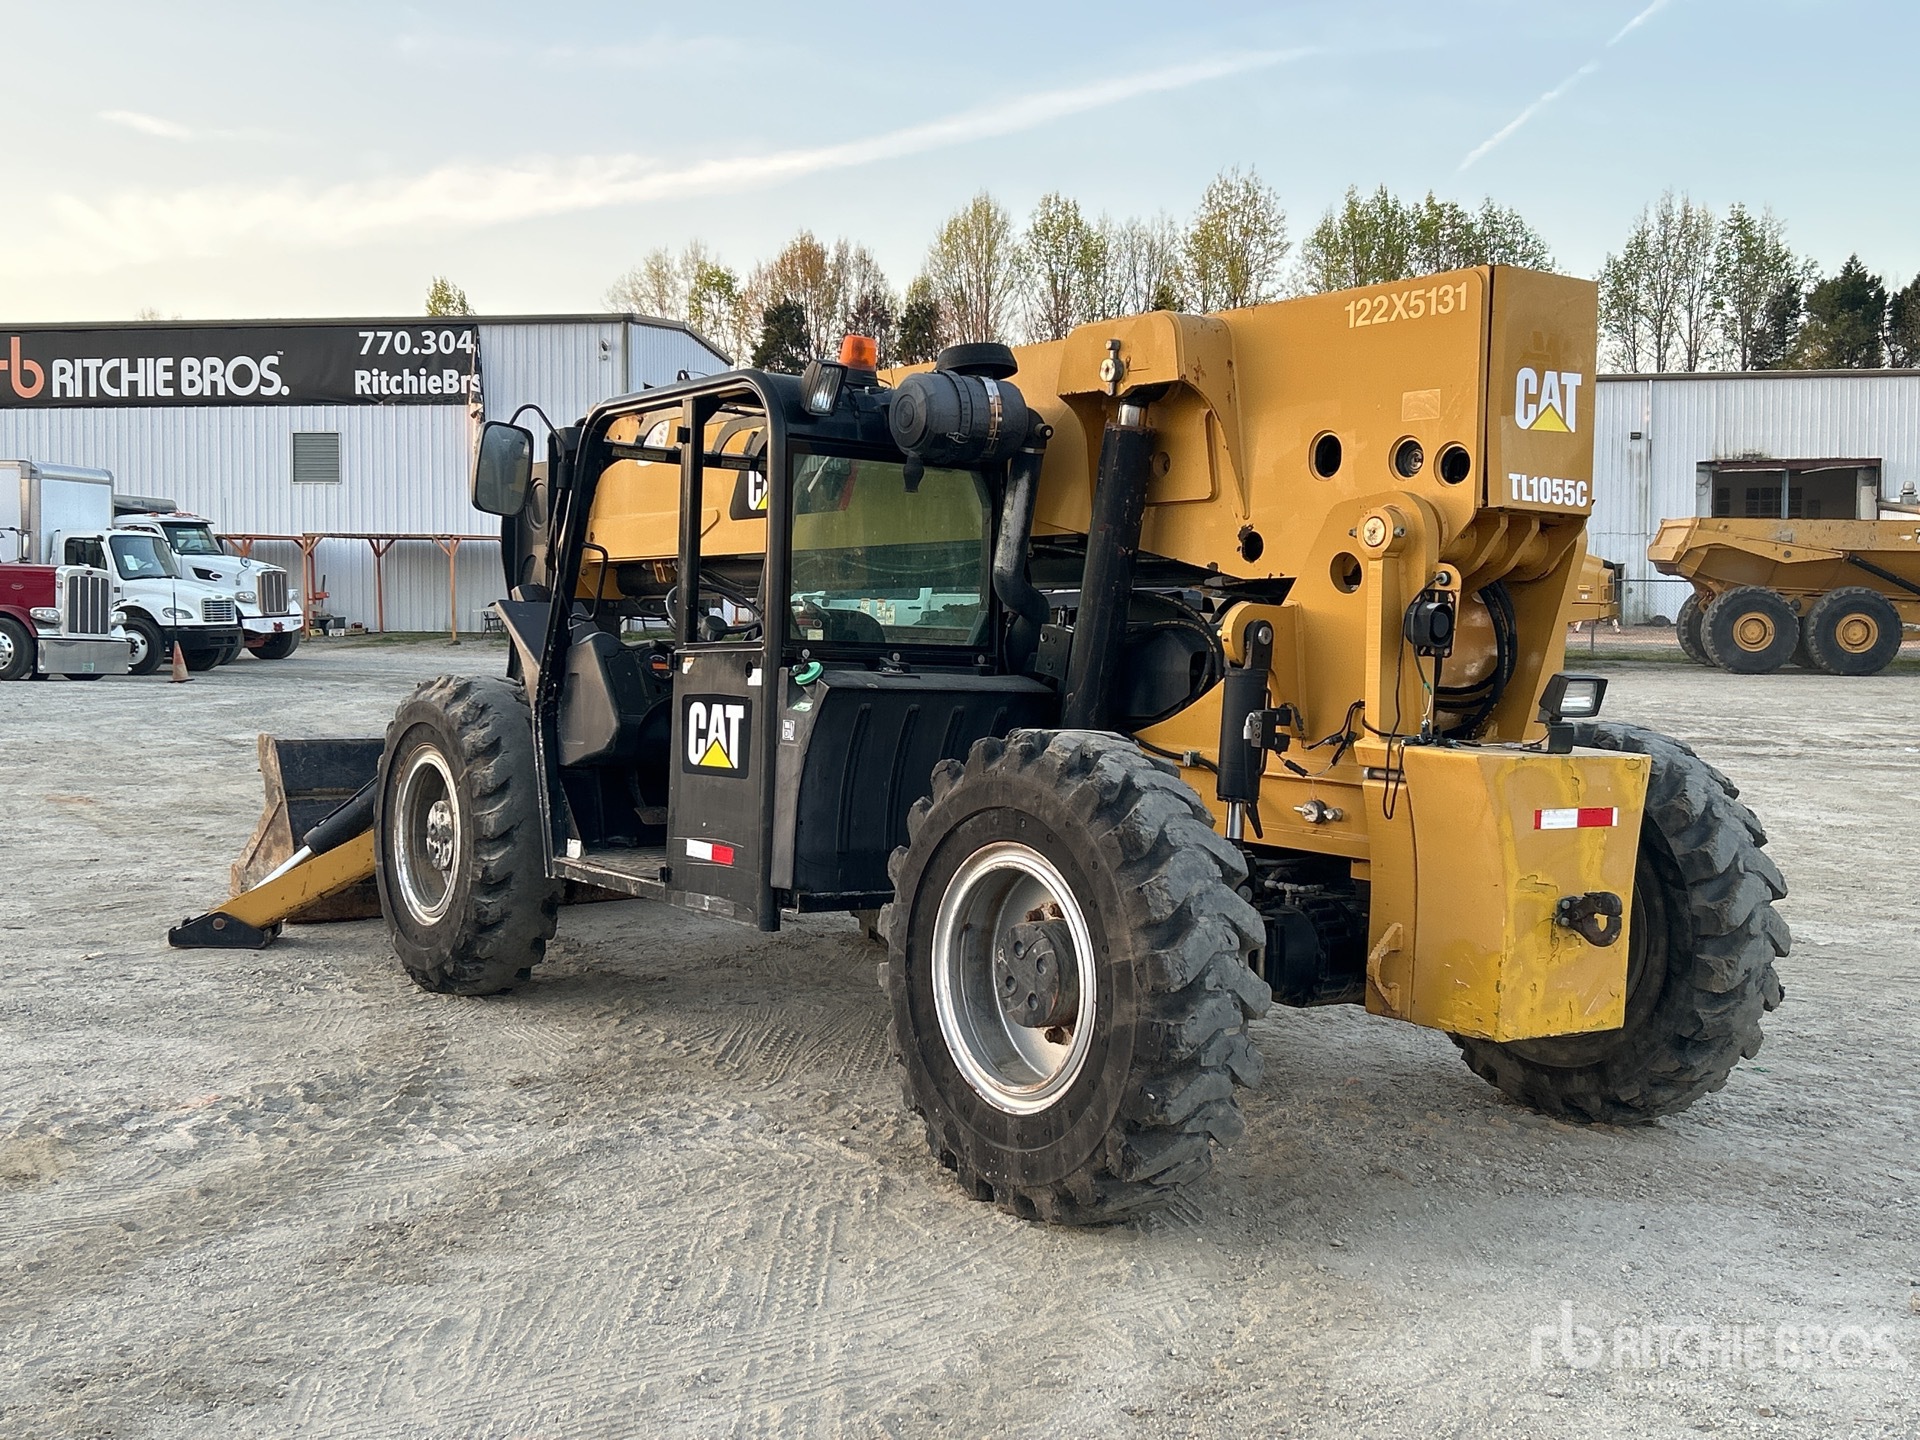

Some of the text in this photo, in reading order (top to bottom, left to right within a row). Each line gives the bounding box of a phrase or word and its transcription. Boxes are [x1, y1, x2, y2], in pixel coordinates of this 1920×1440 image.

[1344, 281, 1467, 329] 122X5131
[358, 330, 475, 355] 770.304
[52, 357, 174, 398] RITCHIE
[180, 355, 290, 396] BROS.
[1515, 367, 1582, 433] CAT
[1508, 473, 1588, 508] TL1055C
[688, 701, 744, 769] CAT
